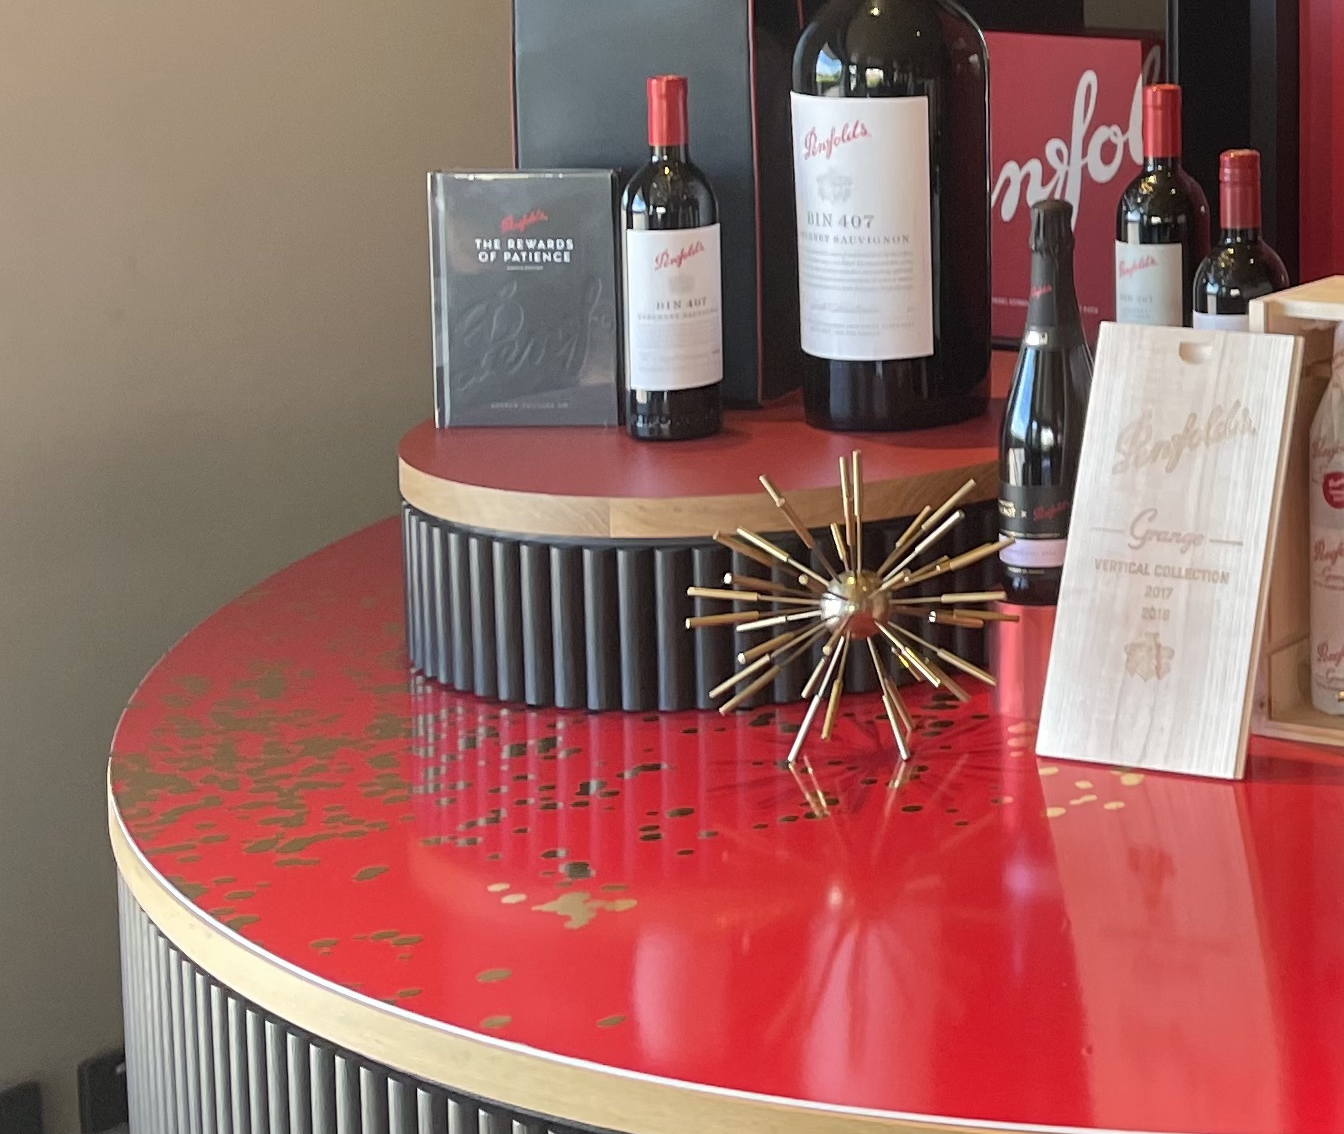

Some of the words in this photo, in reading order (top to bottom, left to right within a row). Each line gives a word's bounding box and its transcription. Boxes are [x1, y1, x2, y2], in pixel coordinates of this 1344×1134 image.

[803, 119, 869, 161] Penfolds
[806, 211, 833, 228] BIN
[838, 213, 875, 230] 407
[474, 237, 502, 251] THE
[507, 238, 574, 251] REWARDS
[478, 251, 497, 263] OF
[503, 251, 571, 263] PATIENCE
[654, 240, 705, 272] Penfolds
[1112, 398, 1257, 475] Penfolds
[1127, 507, 1205, 555] Grange
[1094, 558, 1151, 577] VERTICAL
[1154, 564, 1231, 585] COLLECTION
[1143, 584, 1174, 600] 2017
